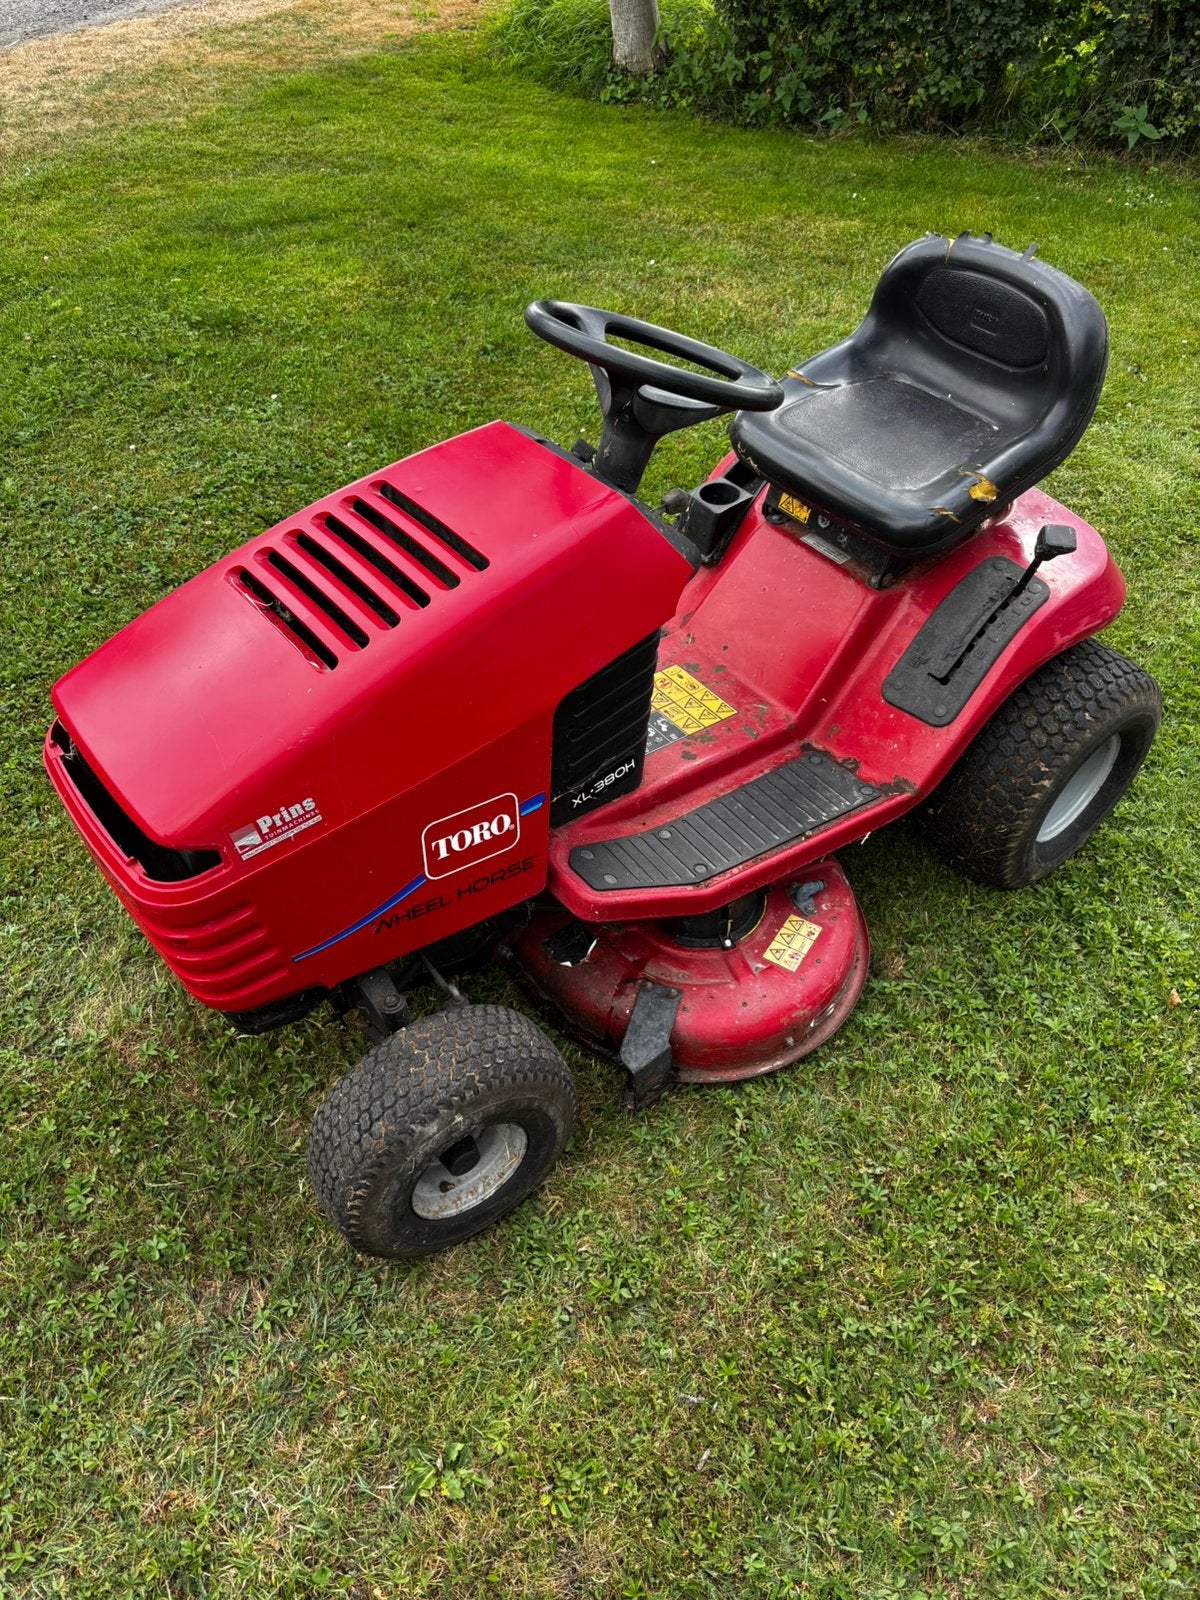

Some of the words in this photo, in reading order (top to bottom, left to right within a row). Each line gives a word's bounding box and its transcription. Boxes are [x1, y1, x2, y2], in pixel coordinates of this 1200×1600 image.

[256, 797, 316, 835] Prins
[264, 809, 320, 841] TUINMACHINES
[371, 895, 450, 933] WHEEL
[456, 855, 537, 899] HORSE
